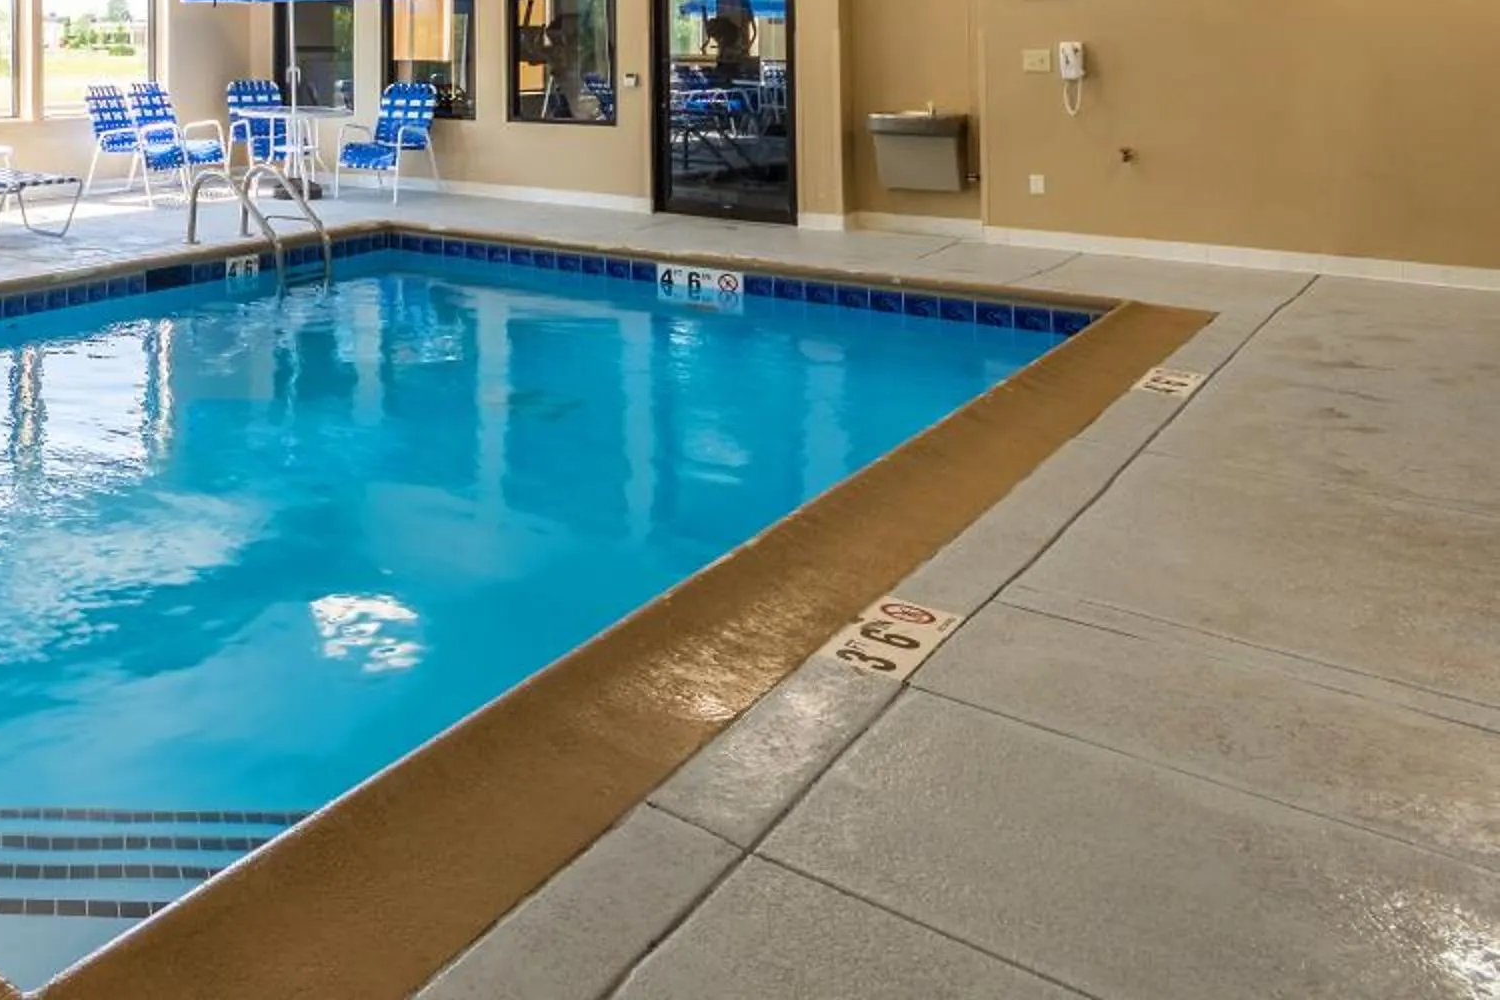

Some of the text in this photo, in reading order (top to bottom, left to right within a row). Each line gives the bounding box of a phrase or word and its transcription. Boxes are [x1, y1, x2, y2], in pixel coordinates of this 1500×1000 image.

[661, 268, 674, 285] 4
[688, 271, 701, 291] 6
[861, 622, 920, 650] 6
[836, 648, 897, 671] 3
